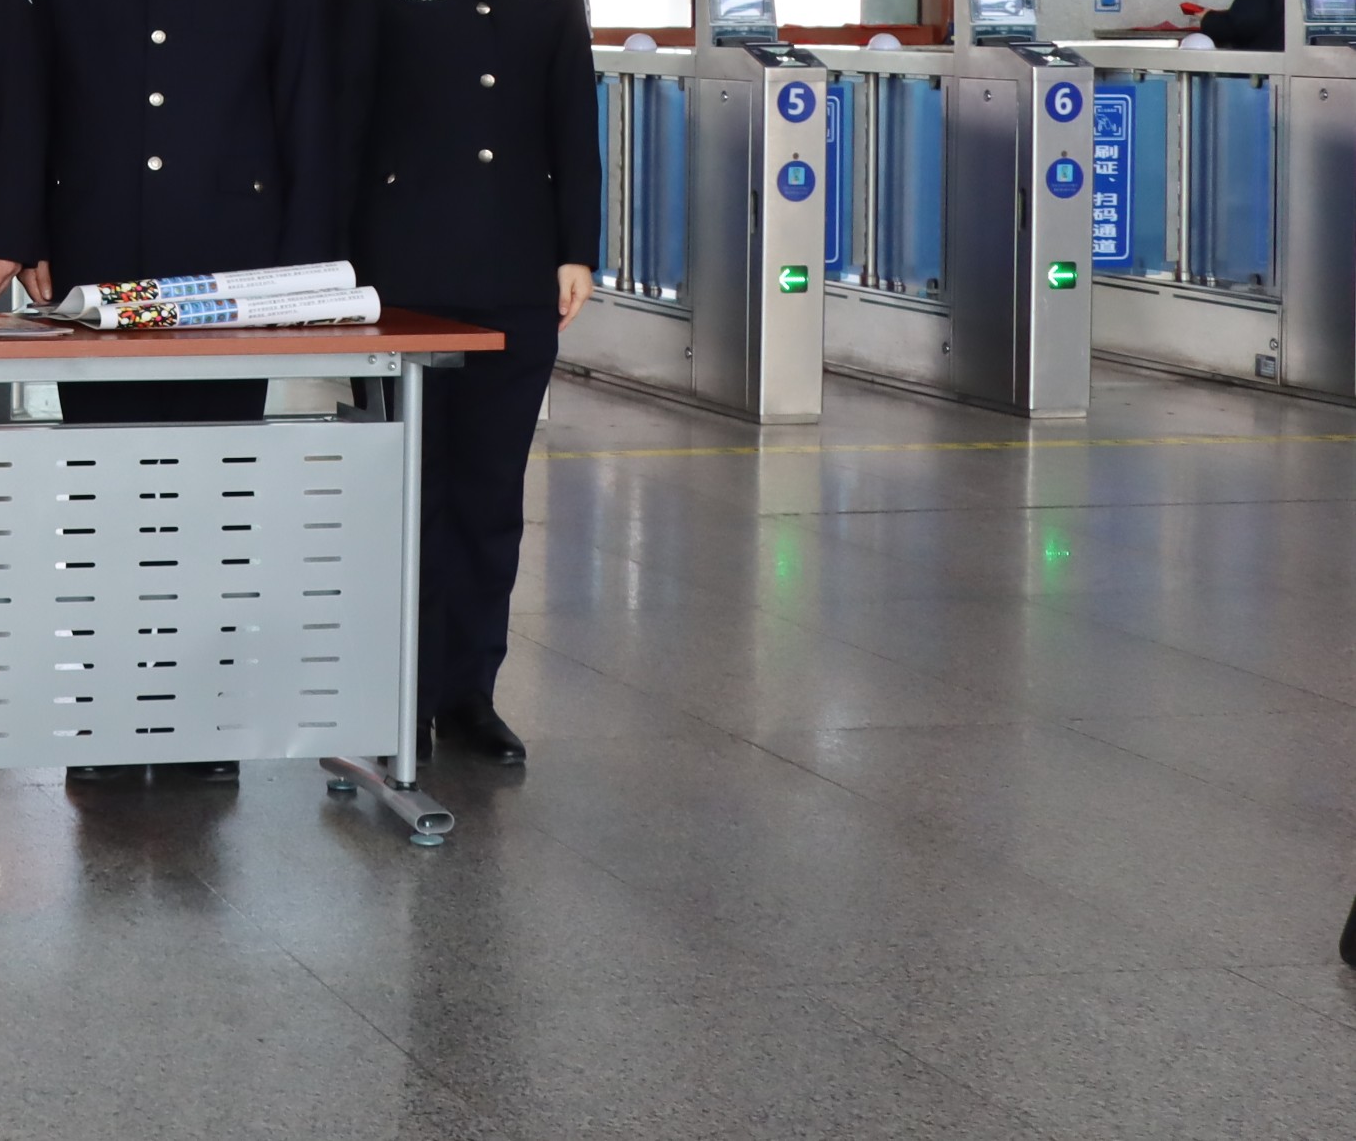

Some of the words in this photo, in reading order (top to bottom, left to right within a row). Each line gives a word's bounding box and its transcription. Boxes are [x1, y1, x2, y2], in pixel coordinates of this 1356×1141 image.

[787, 88, 805, 115] 5
[1054, 88, 1073, 115] 6
[1092, 145, 1119, 253] 刷证、扫码通道
